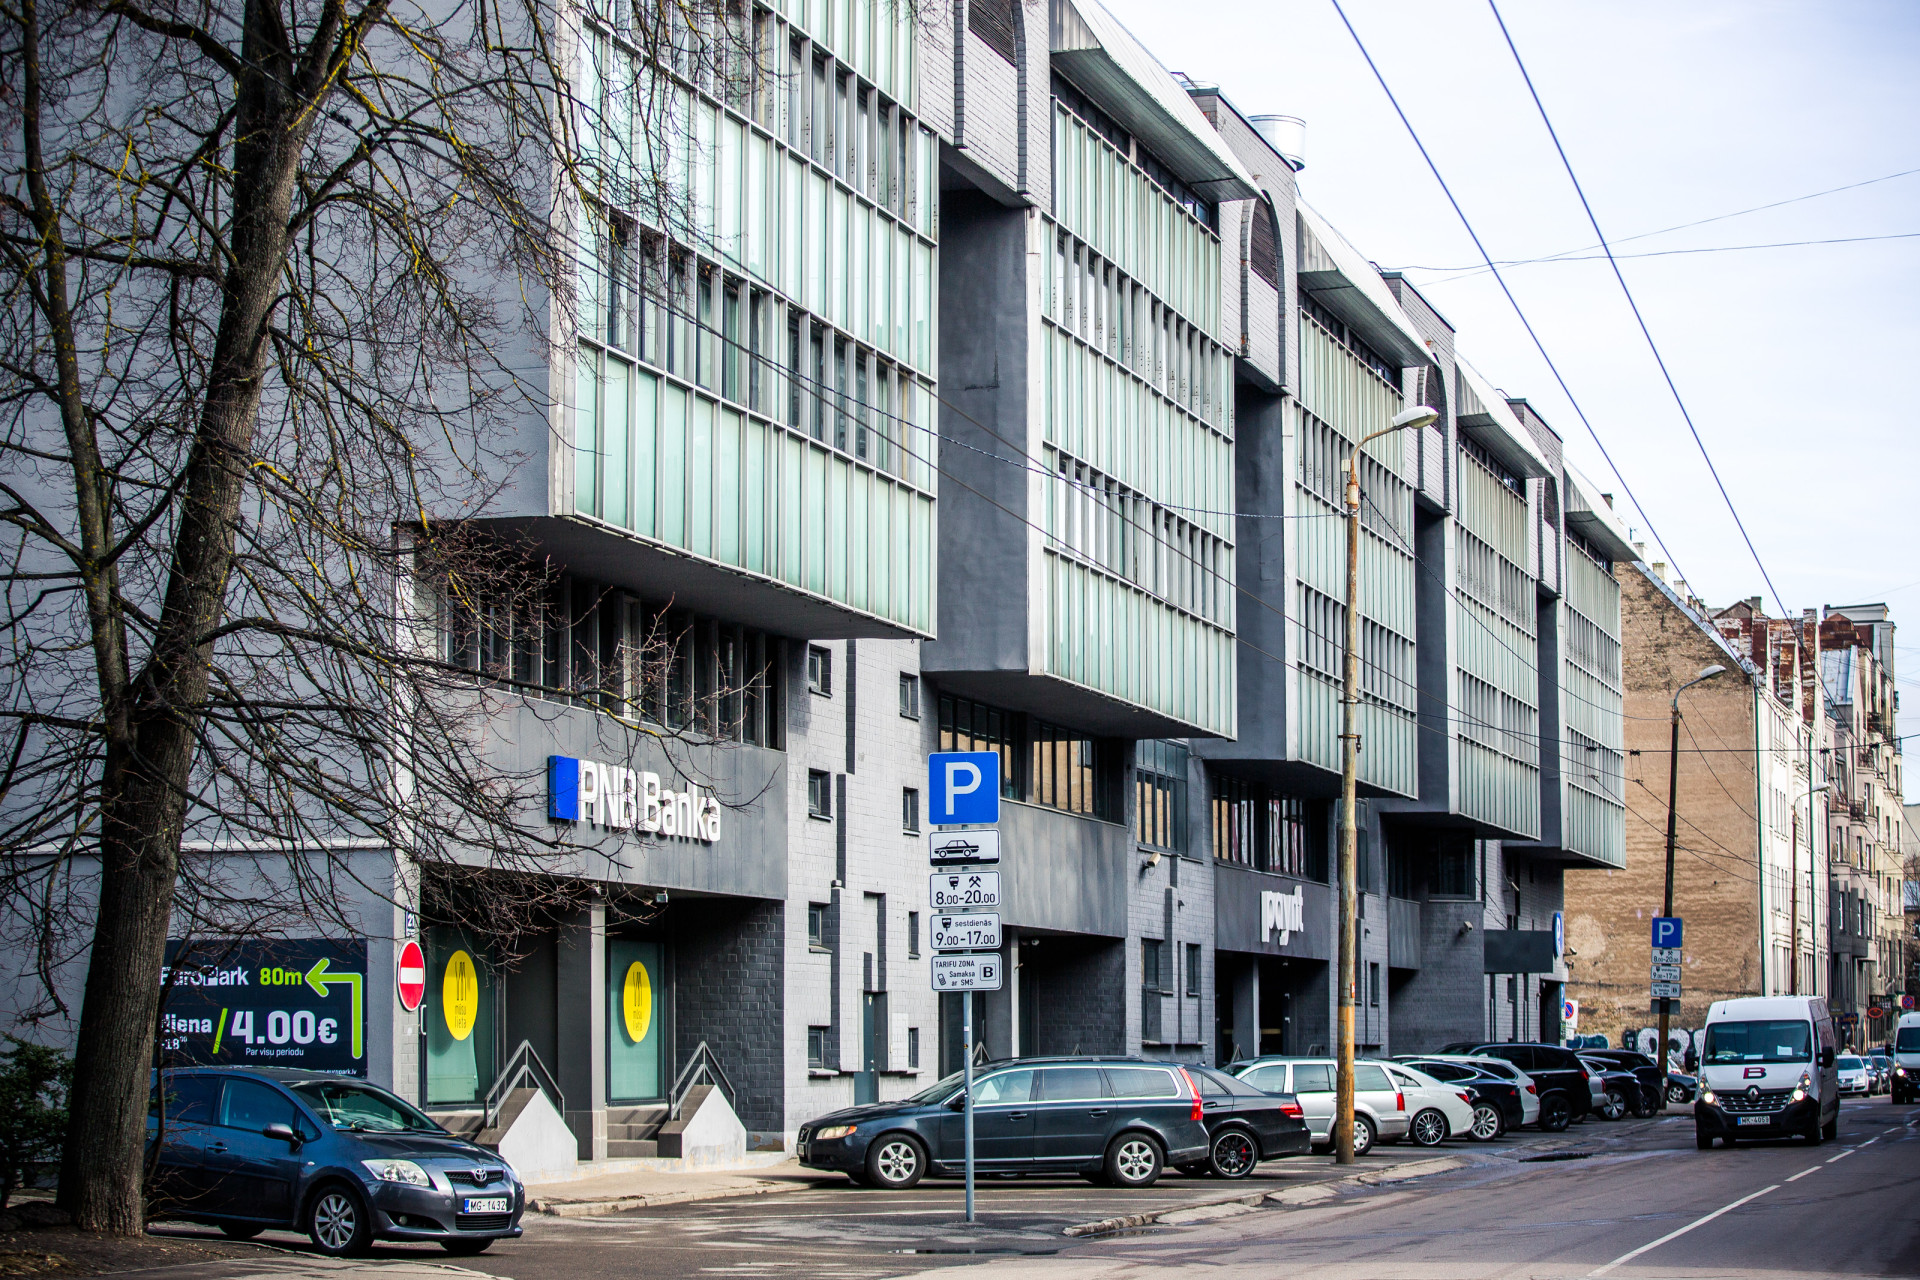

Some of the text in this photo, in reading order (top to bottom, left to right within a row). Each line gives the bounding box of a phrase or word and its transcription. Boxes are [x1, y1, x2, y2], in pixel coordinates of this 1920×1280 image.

[945, 761, 982, 815] P
[578, 759, 721, 842] PNB Banka
[935, 889, 996, 905] 8.00-20.00
[954, 919, 993, 928] sestdienās
[935, 930, 996, 946] 9.00-17.00
[1658, 921, 1675, 944] P
[935, 960, 975, 968] TARIFU ZONA
[259, 967, 303, 986] 80m
[949, 970, 976, 978] Samaksa
[983, 966, 994, 978] B
[960, 978, 974, 986] SMS
[230, 1009, 339, 1045] 4.00€
[245, 1047, 304, 1058] Par visu periodu
[1743, 1067, 1767, 1080] B
[470, 1200, 506, 1211] MG-1432
